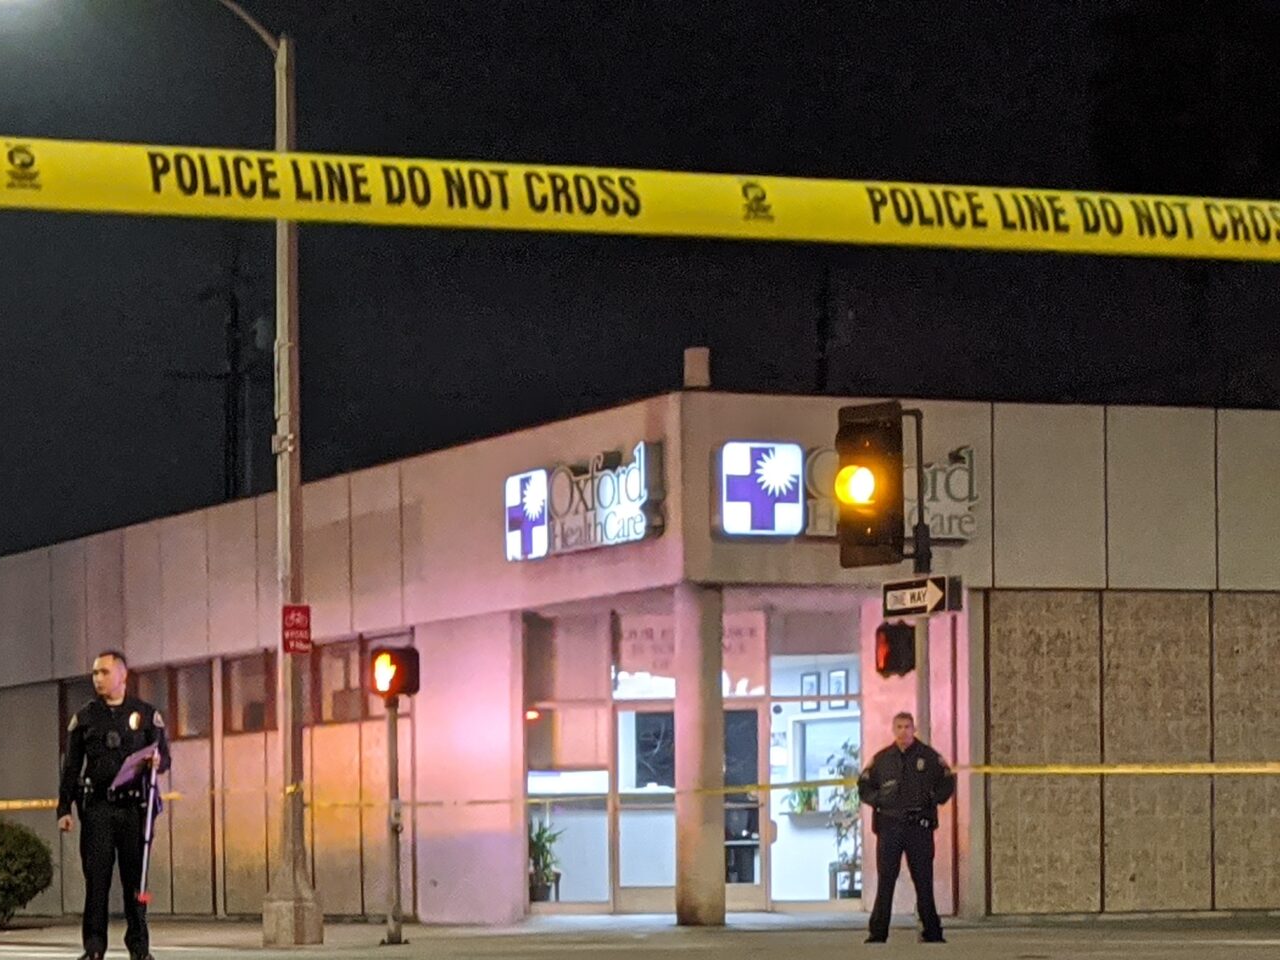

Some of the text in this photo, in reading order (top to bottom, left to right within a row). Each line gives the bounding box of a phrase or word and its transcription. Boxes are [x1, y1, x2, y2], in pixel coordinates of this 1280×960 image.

[149, 152, 642, 218] POLICE LINE DO NOT CROSS
[866, 187, 988, 229] POLICE
[994, 194, 1070, 233] LINE
[1076, 198, 1124, 236] DO
[1131, 201, 1194, 239] NOT
[550, 441, 647, 519] Oxford
[552, 508, 644, 548] HealthCare
[909, 589, 927, 604] WAY
